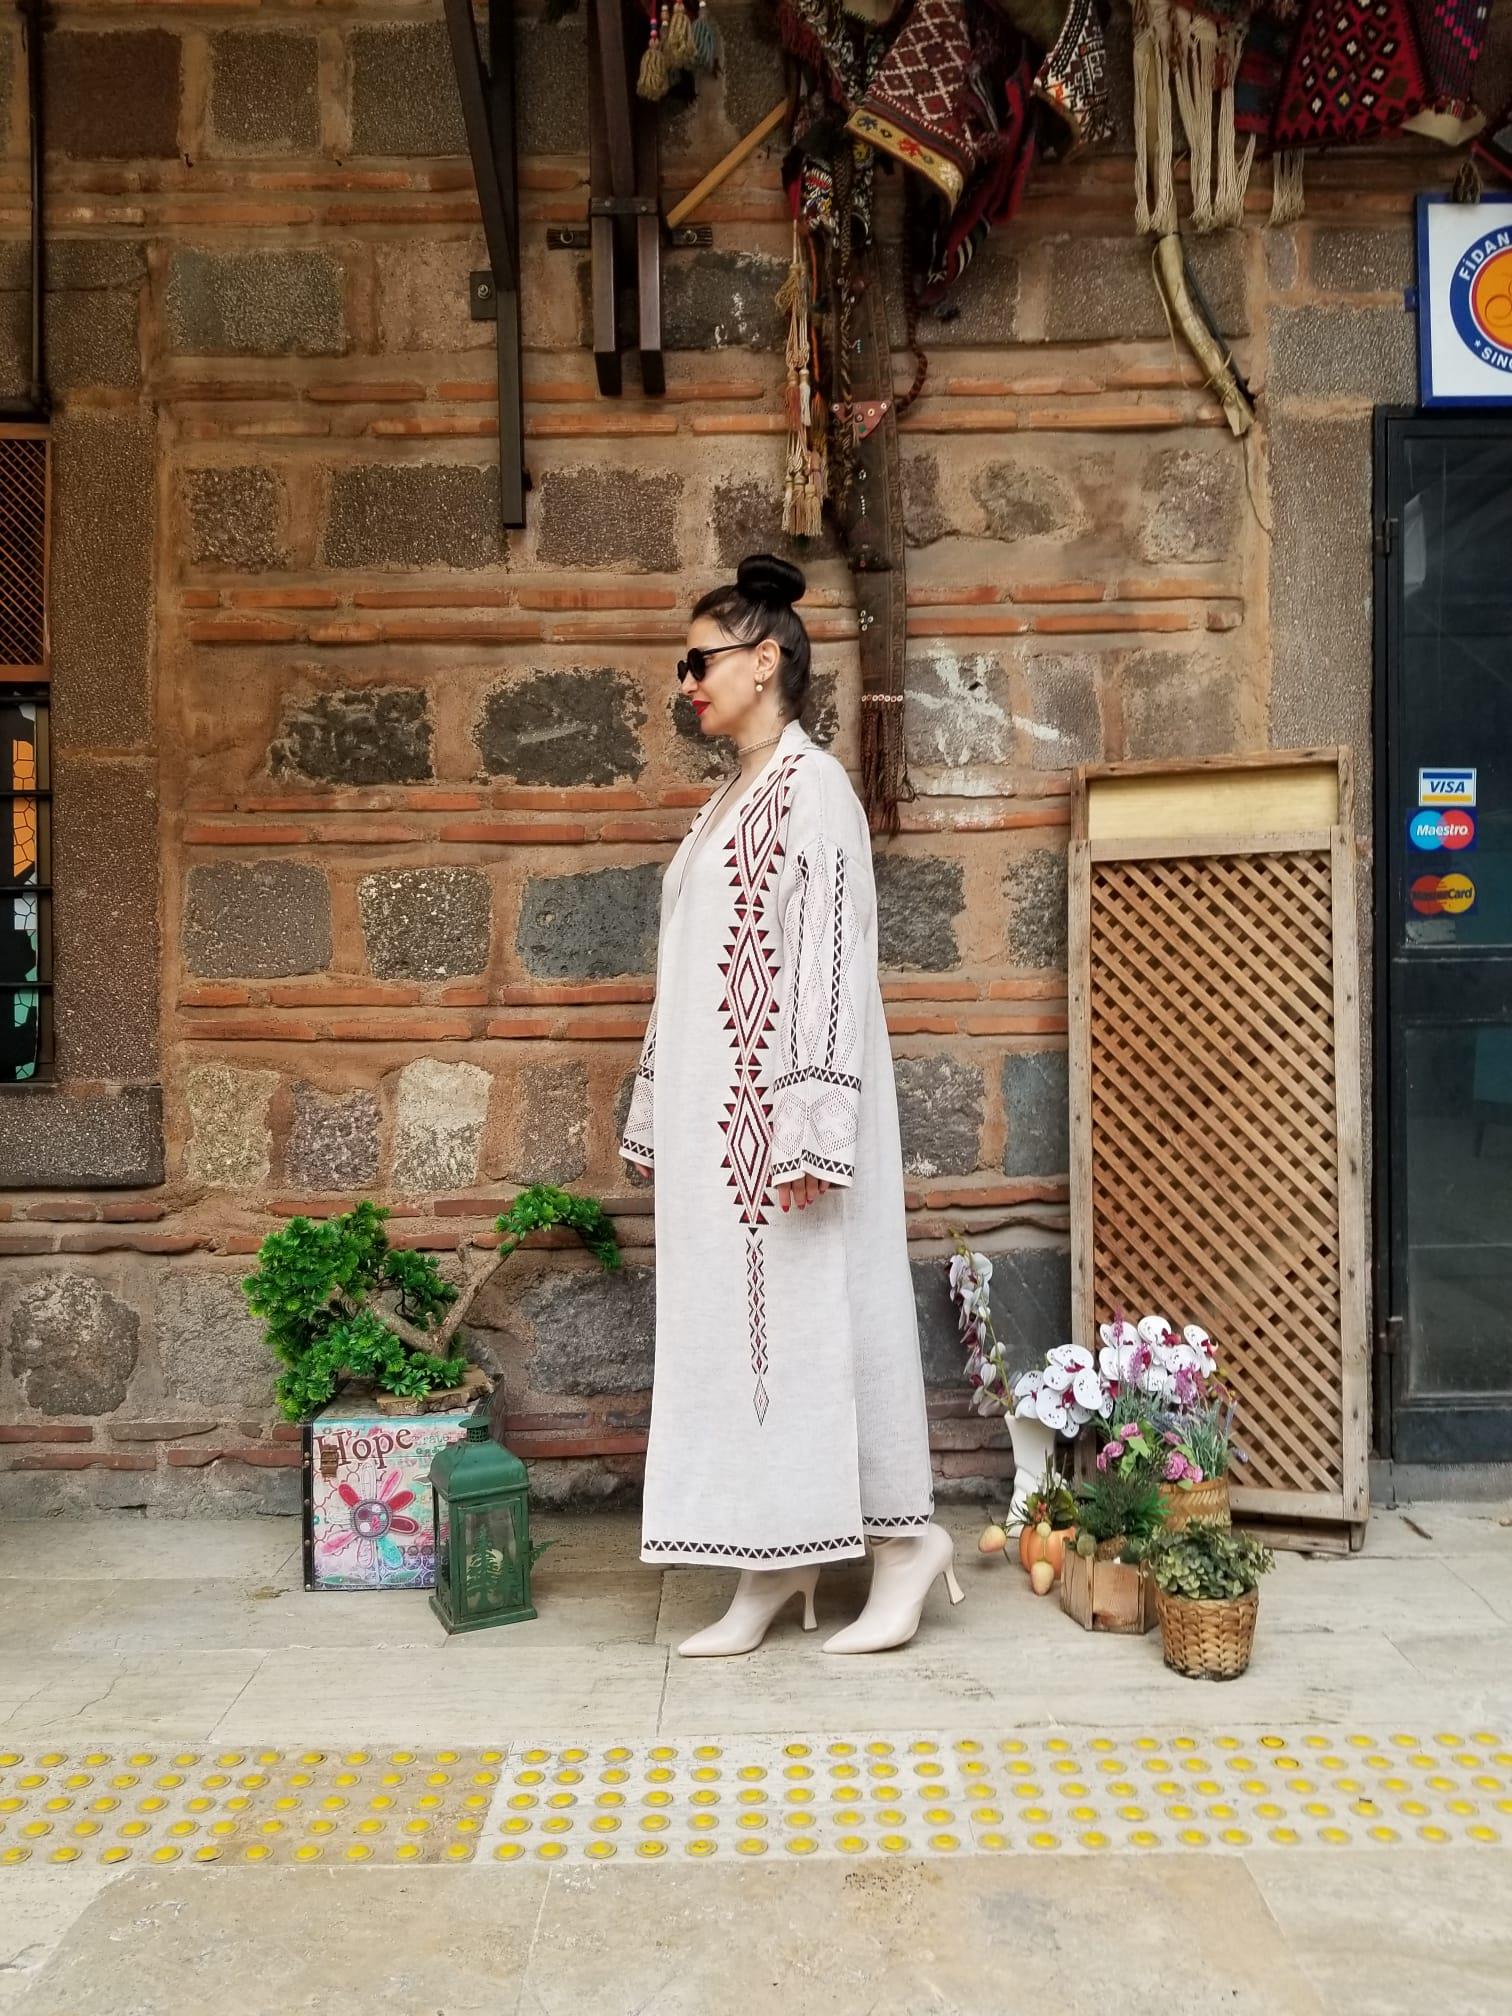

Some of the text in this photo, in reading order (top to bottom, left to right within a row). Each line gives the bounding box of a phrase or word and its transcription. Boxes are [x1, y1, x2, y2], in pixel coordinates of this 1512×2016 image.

[1458, 231, 1510, 280] FİDAN
[1430, 780, 1465, 793] VISA
[1416, 823, 1469, 837] Maestro
[313, 1428, 414, 1470] Hope
